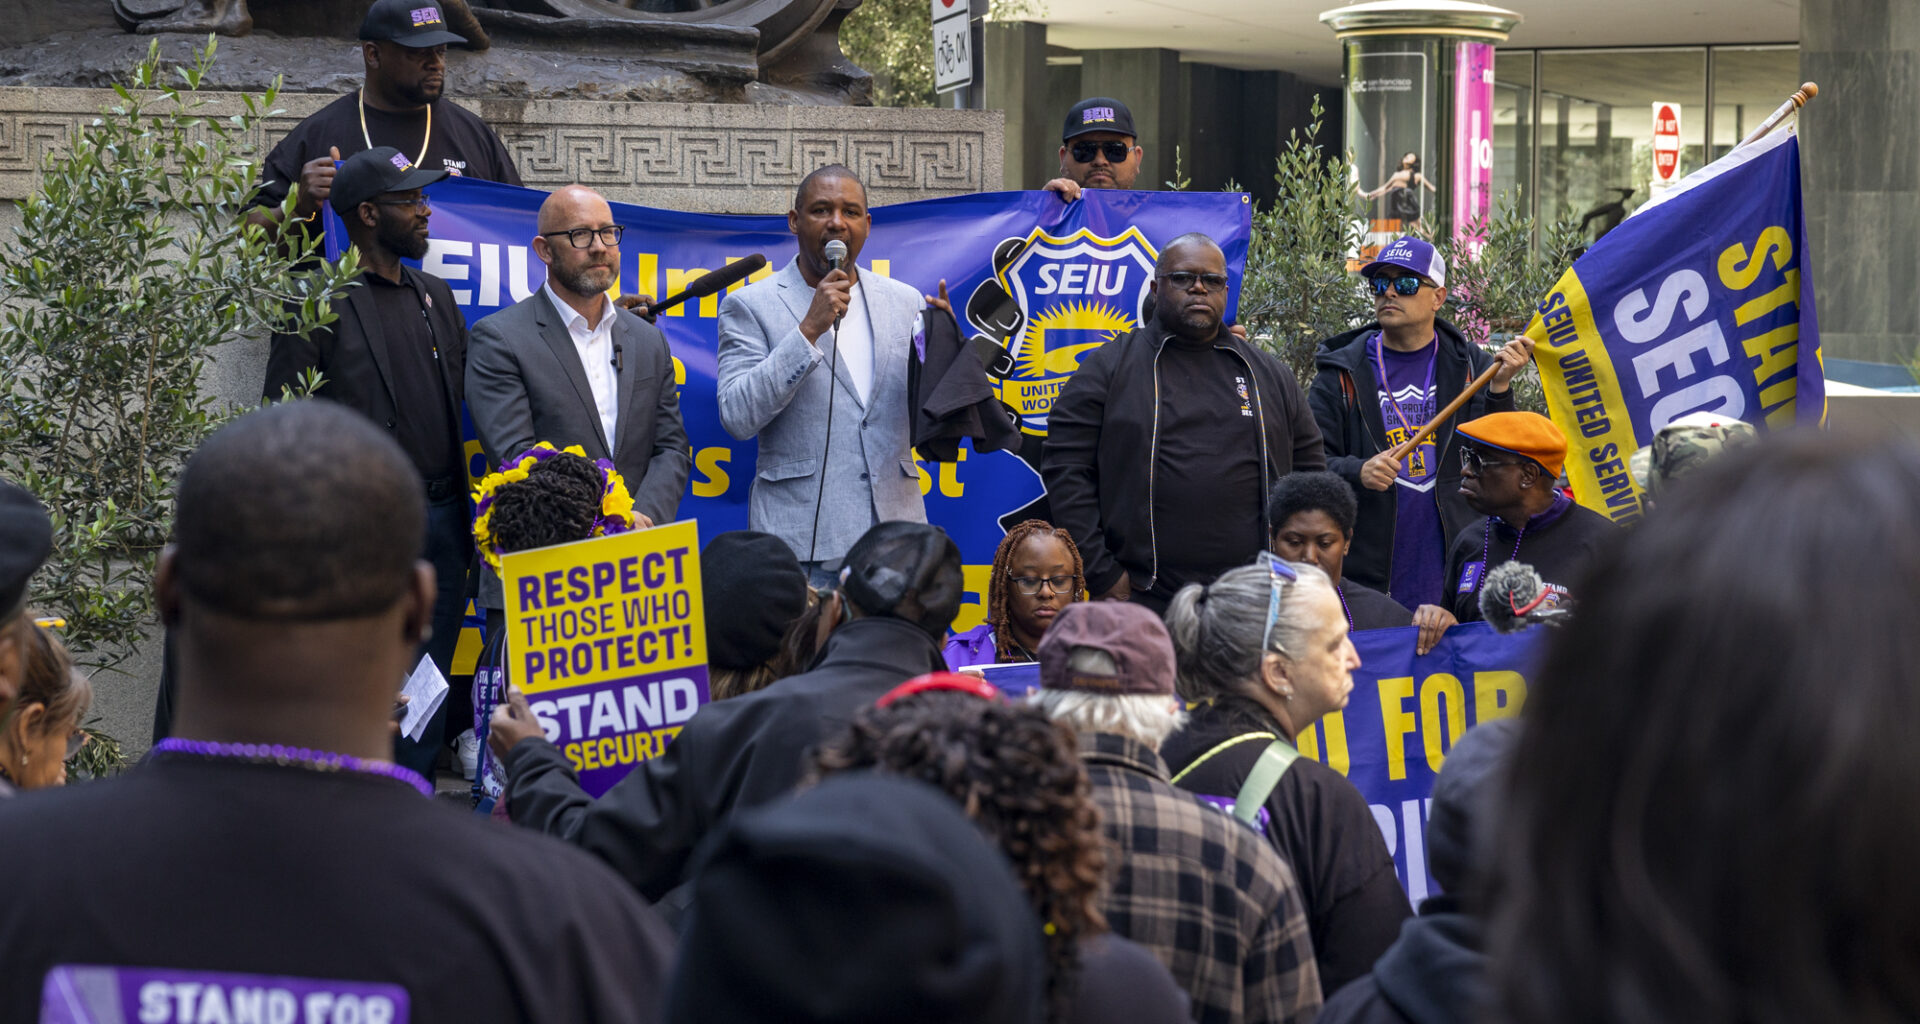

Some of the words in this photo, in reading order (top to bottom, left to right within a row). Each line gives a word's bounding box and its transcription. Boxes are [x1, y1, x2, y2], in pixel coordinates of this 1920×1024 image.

[956, 31, 968, 63] OK
[1083, 107, 1114, 121] SEIU
[1665, 119, 1676, 132] NOT
[443, 158, 466, 169] STAND
[1658, 153, 1674, 167] ENTER
[1385, 248, 1413, 258] SEIU6
[1035, 263, 1128, 296] SEIU
[1538, 291, 1579, 348] SEIU
[1021, 381, 1066, 397] UNITE
[1558, 348, 1612, 439] UNITED
[518, 546, 689, 613] RESPECT
[520, 602, 615, 647] THOSE
[622, 589, 691, 629] WHO
[524, 624, 693, 685] PROTECT!
[529, 677, 699, 743] STAND
[564, 725, 684, 772] SECURIT
[137, 980, 298, 1024] STAND
[303, 991, 395, 1024] FOR
